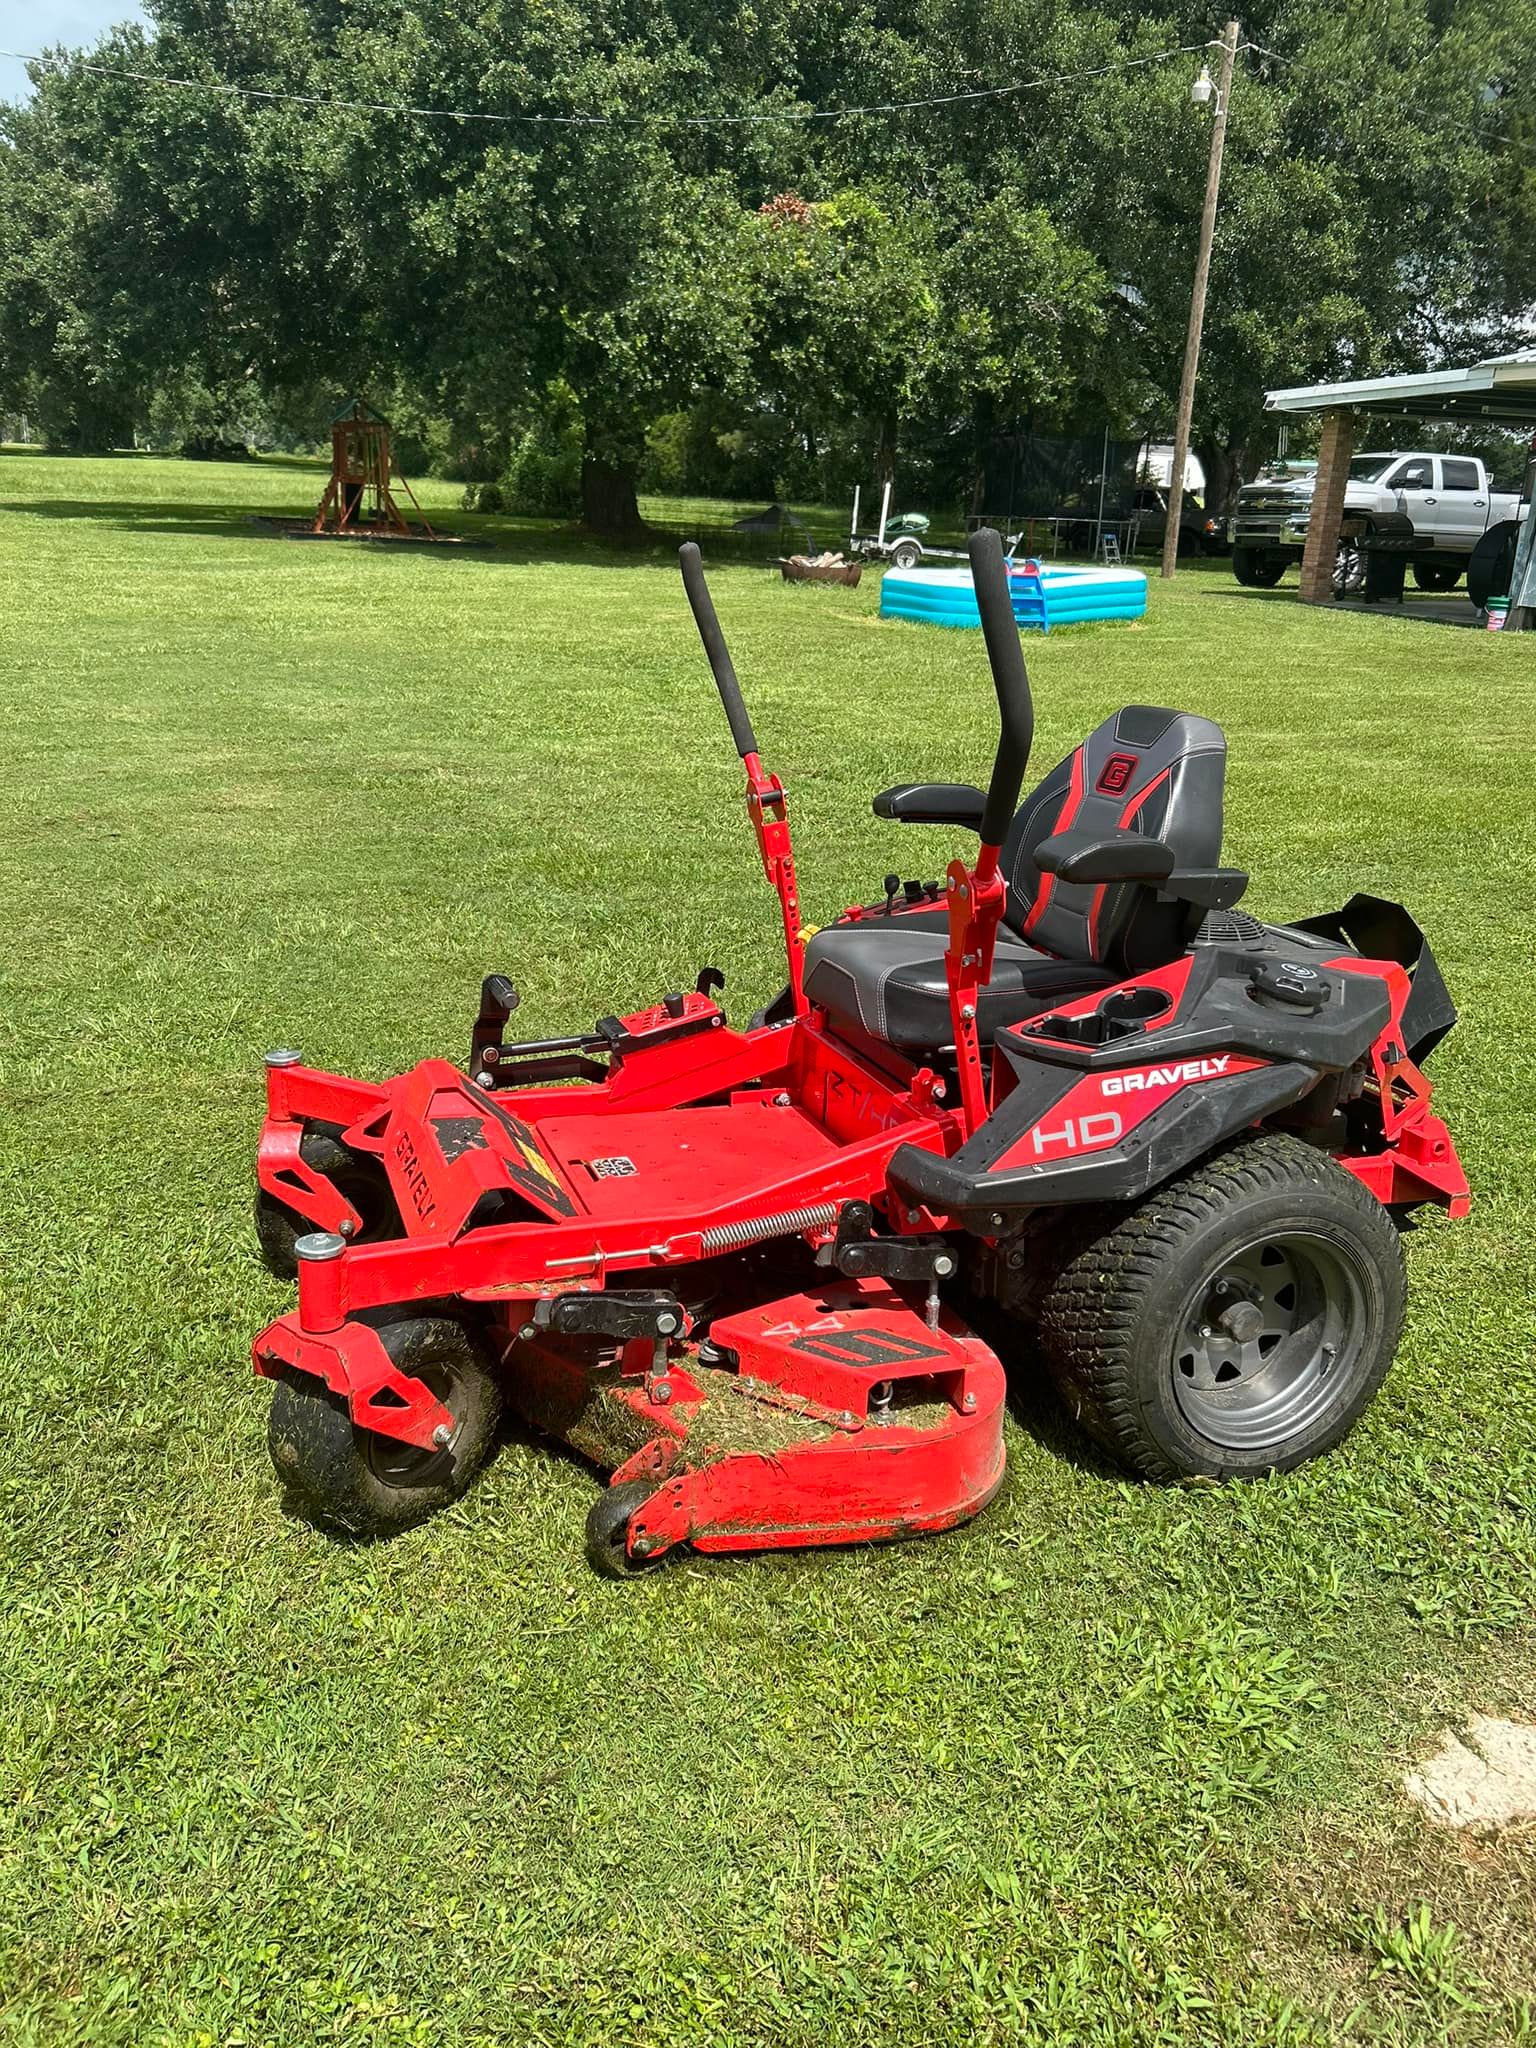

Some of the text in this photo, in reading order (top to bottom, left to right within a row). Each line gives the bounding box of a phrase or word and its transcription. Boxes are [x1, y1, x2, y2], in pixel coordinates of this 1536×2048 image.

[1101, 1055, 1231, 1097] GRAVELY
[1032, 1111, 1123, 1154] HD
[396, 1130, 436, 1222] GRAVELY
